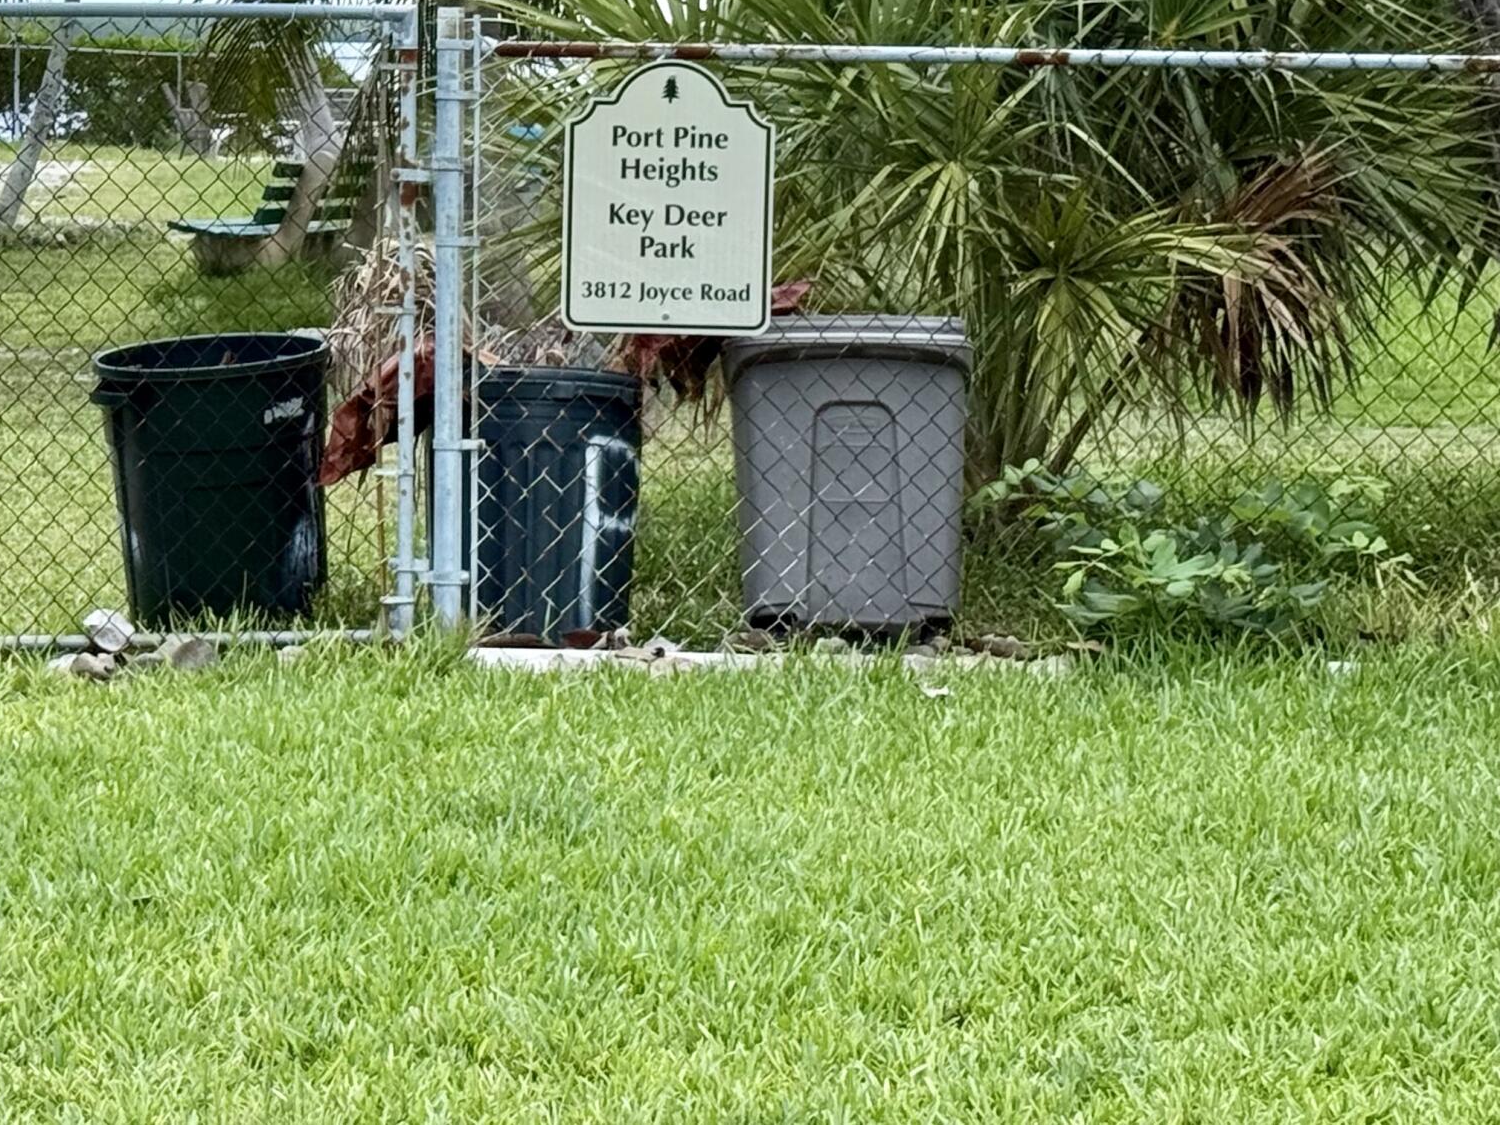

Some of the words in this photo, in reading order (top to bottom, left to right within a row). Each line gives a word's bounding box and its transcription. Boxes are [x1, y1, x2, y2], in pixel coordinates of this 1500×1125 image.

[611, 124, 664, 148] Port
[673, 125, 729, 149] Pine
[620, 157, 719, 188] Heights
[608, 203, 655, 232] Key
[665, 204, 728, 227] Deer
[639, 235, 696, 259] Park
[580, 281, 631, 299] 3812
[638, 282, 693, 306] Joyce
[700, 283, 751, 302] Road
